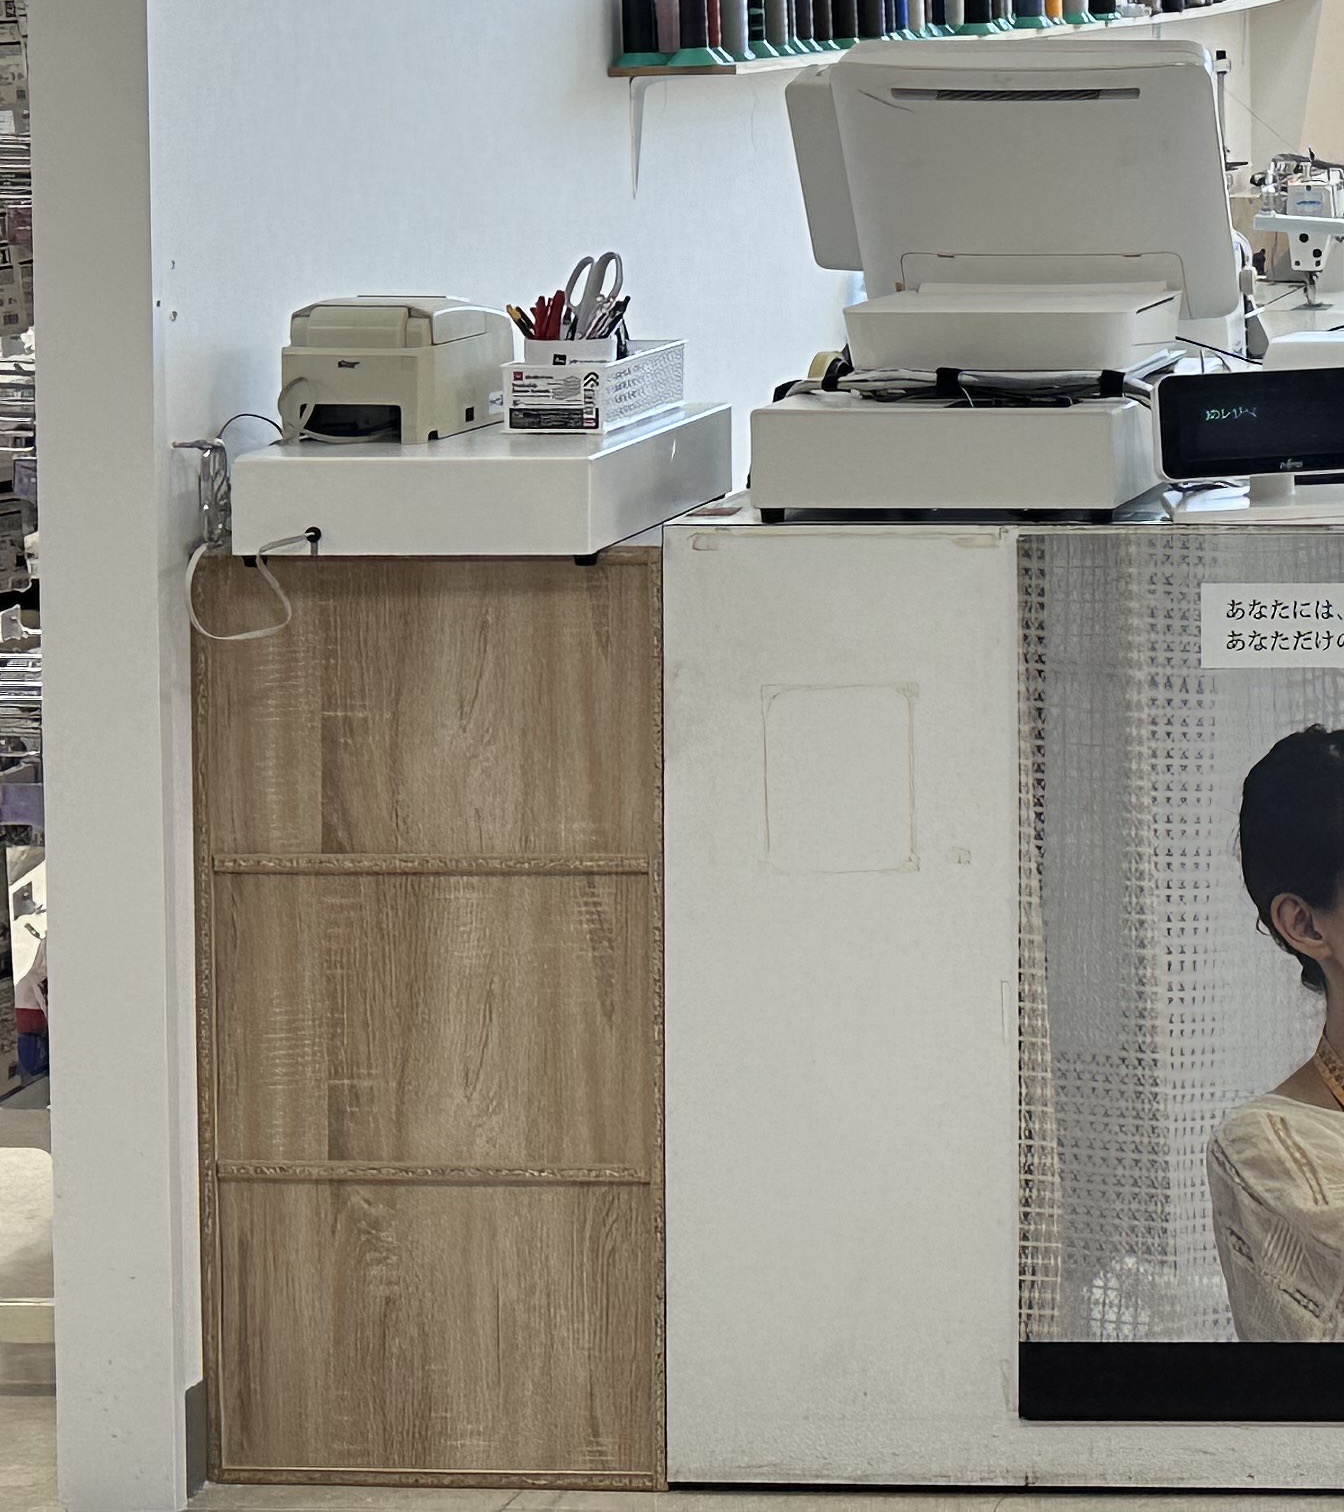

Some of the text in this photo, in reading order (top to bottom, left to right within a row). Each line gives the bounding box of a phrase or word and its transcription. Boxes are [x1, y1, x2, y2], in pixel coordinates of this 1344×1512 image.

[1226, 599, 1344, 620] あなたには、
